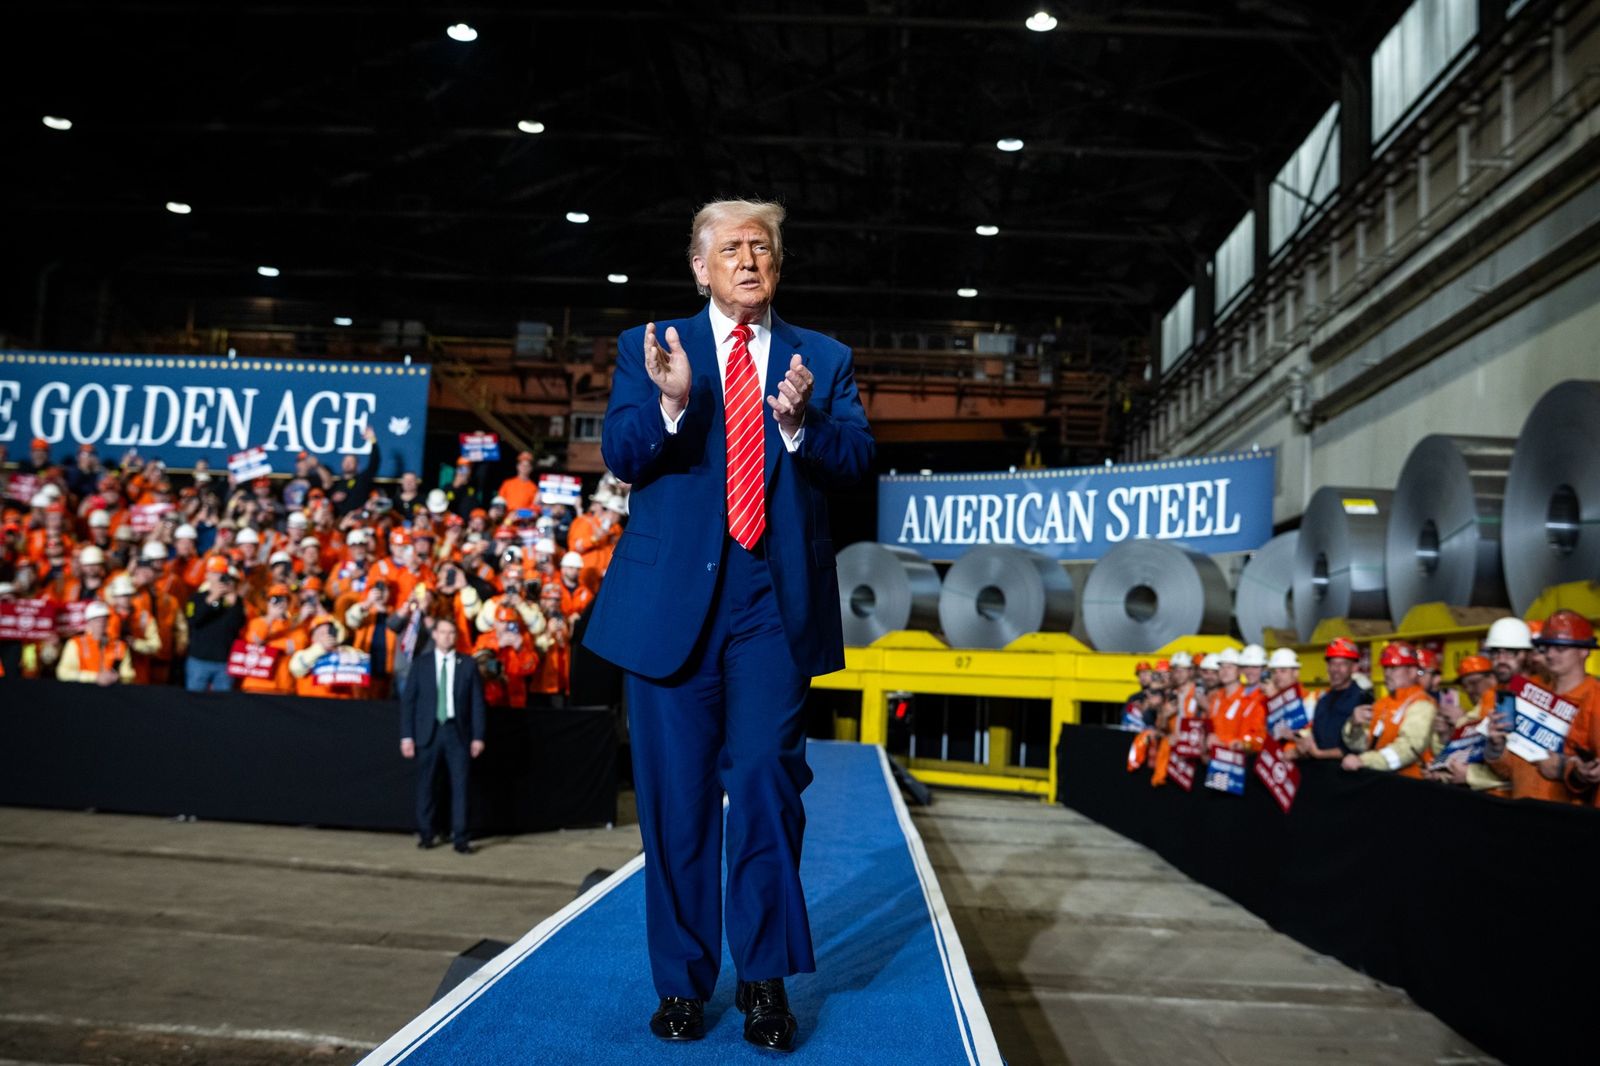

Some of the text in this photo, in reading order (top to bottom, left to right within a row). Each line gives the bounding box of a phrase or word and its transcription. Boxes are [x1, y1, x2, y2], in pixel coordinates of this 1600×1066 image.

[30, 381, 260, 450] GOLDEN
[262, 389, 377, 455] AGE
[897, 478, 1241, 545] AMERICAN STEEL
[1520, 682, 1554, 711] STEEL
